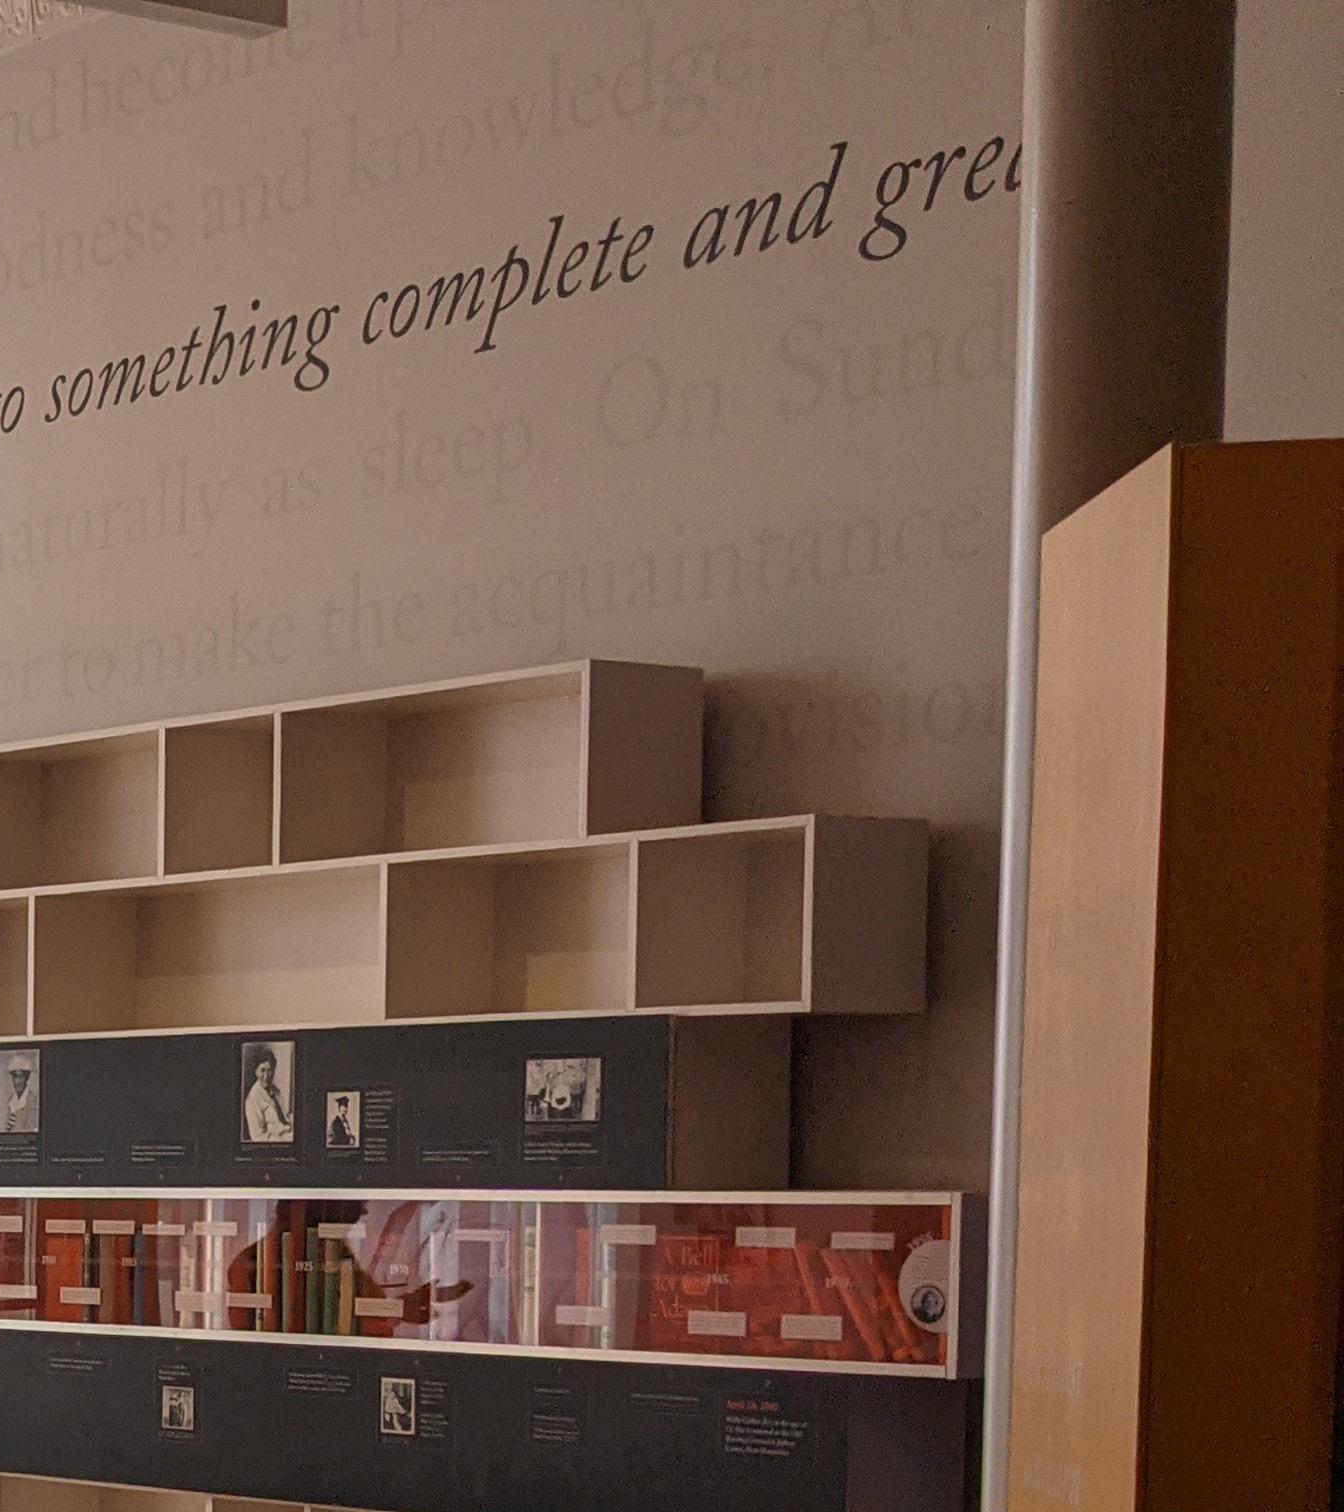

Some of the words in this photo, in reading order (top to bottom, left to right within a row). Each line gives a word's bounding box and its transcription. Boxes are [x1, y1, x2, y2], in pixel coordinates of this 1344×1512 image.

[43, 299, 341, 397] something
[363, 214, 654, 354] complete
[683, 141, 848, 269] and
